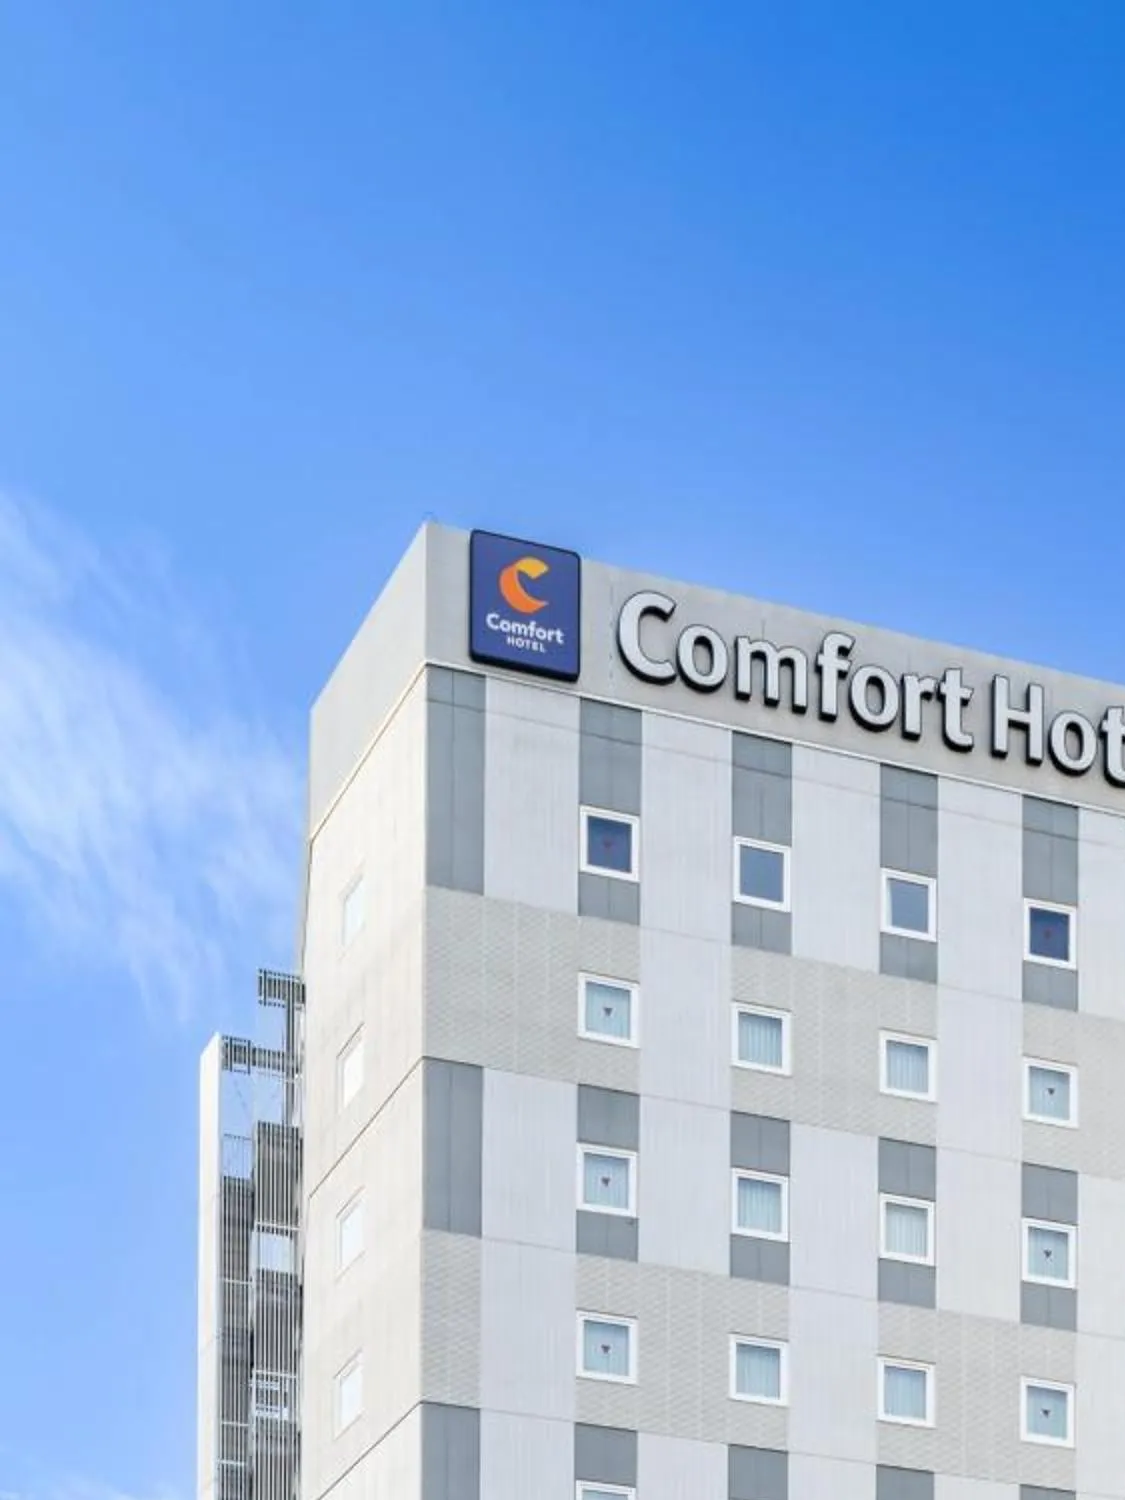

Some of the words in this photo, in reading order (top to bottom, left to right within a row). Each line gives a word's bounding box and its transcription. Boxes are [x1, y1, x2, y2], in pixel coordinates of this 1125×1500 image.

[485, 611, 565, 644] Comfort
[506, 636, 547, 653] HOTEL
[617, 589, 976, 750] Comfort
